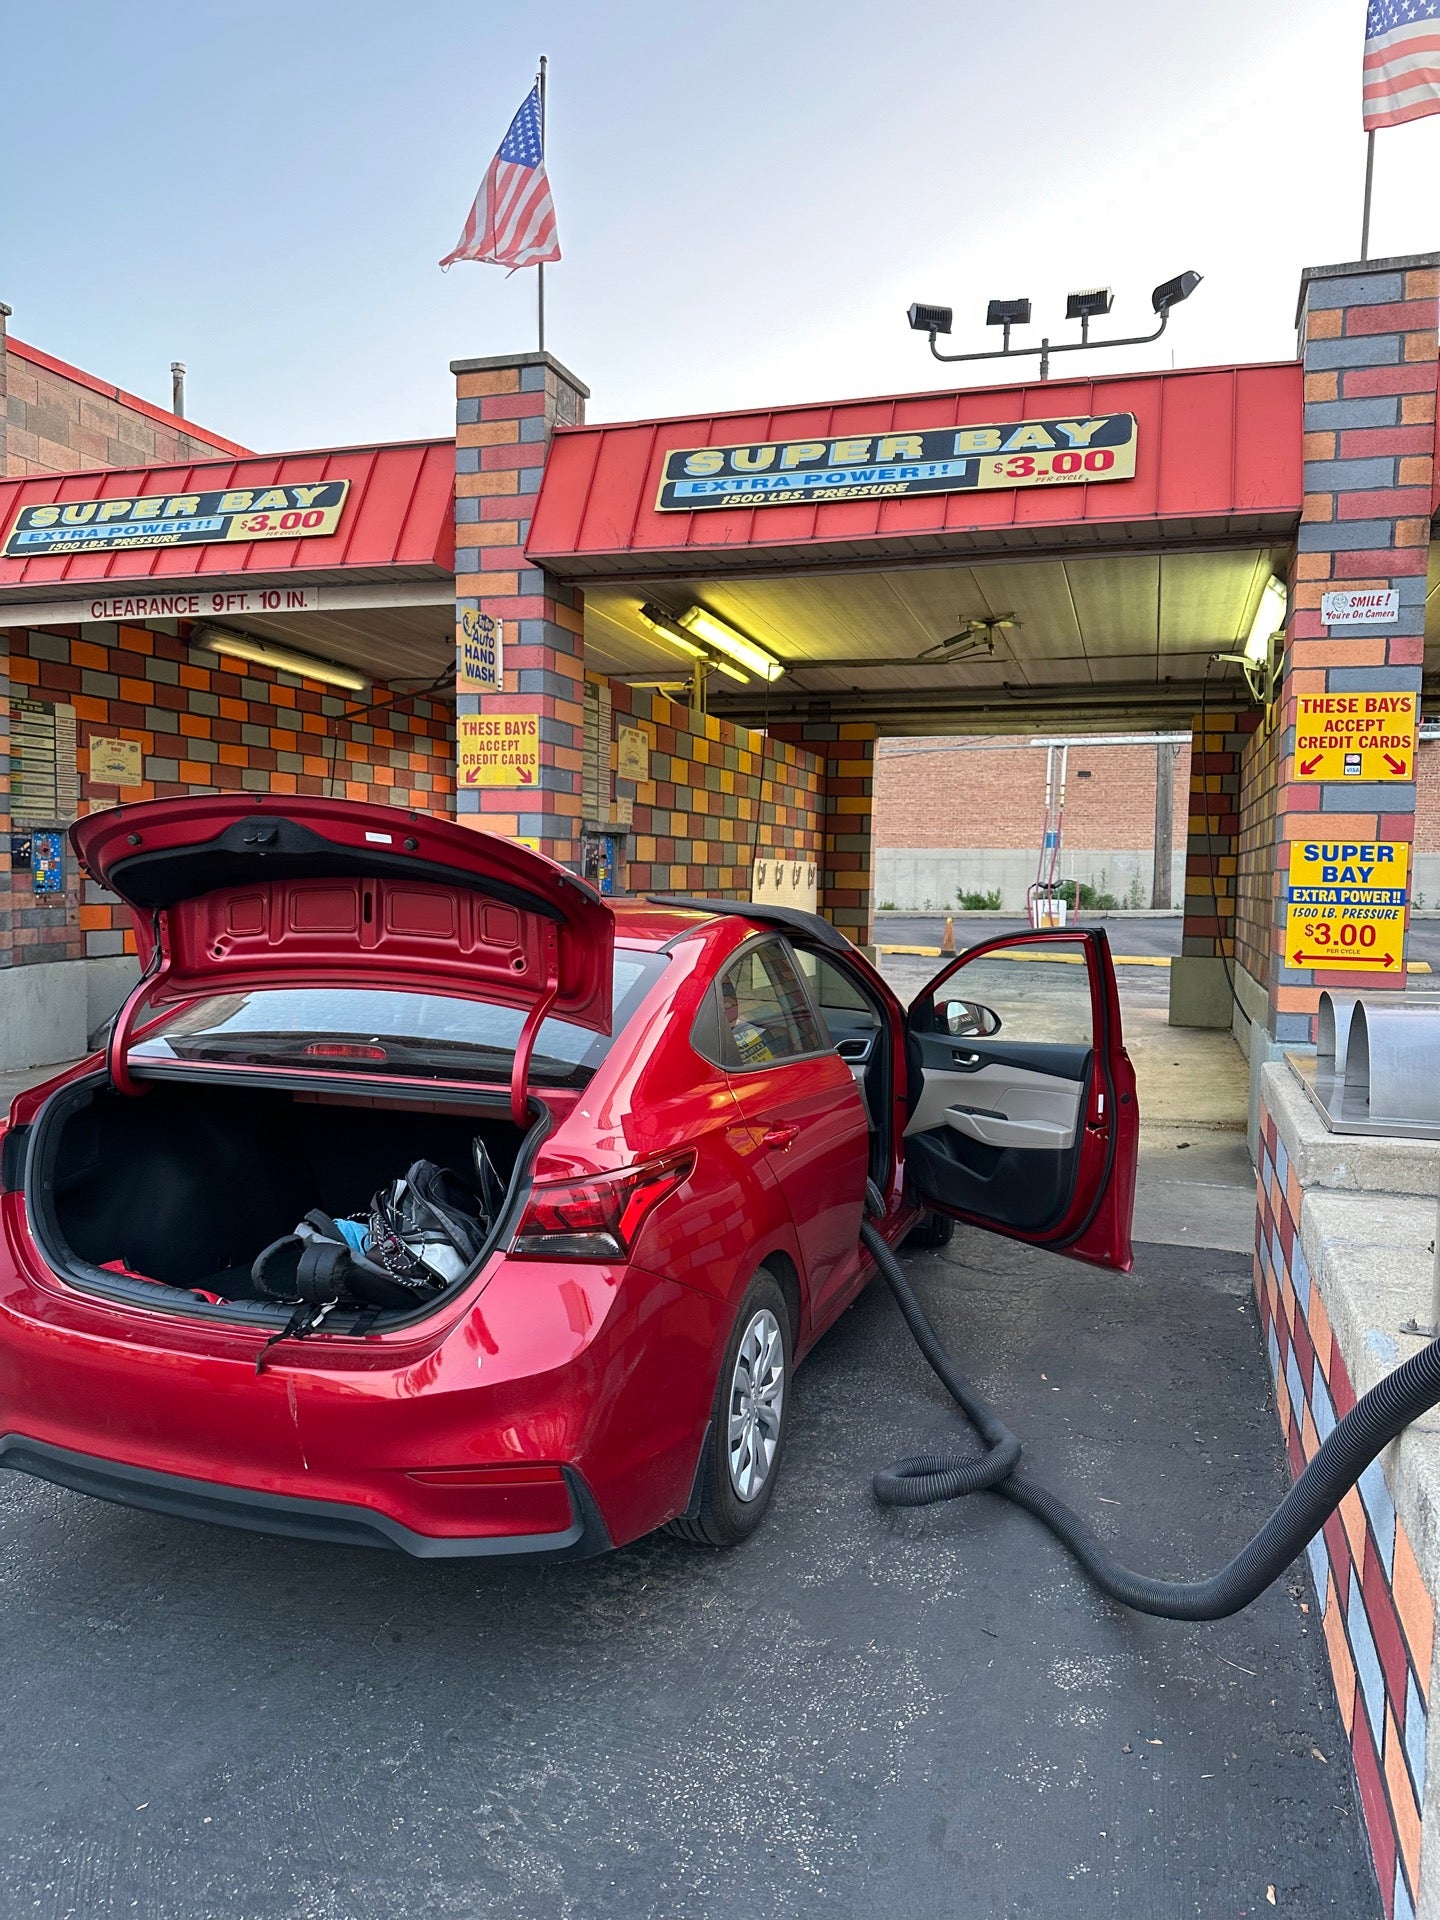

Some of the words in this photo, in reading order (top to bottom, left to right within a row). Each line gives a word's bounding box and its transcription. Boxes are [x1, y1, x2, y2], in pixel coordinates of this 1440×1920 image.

[683, 434, 923, 477] SUPER
[954, 420, 1110, 455] BAY
[993, 449, 1115, 478] $3.00
[691, 476, 793, 494] EXTRA
[721, 493, 765, 506] 1500
[769, 490, 806, 502] LBS.
[813, 483, 910, 500] PRESSURE
[29, 496, 200, 527] SUPER
[216, 484, 330, 514] BAY
[240, 510, 325, 532] $3.00
[28, 528, 100, 542] EXTRA
[48, 542, 80, 551] 1500
[81, 539, 107, 548] LBS.
[112, 534, 182, 547] PRESSURE
[91, 596, 200, 619] CLEARANCE
[259, 590, 281, 609] 10
[286, 591, 308, 608] IN.
[1327, 610, 1350, 620] You're
[1352, 610, 1364, 619] On
[1365, 609, 1395, 619] Camera
[472, 629, 495, 648] Auto
[465, 643, 495, 665] HAND
[465, 662, 495, 683] WASH
[1302, 698, 1358, 714] THESE
[1365, 697, 1412, 713] BAYS
[462, 722, 500, 736] THESE
[504, 721, 536, 735] BAYS
[1324, 719, 1385, 732] ACCEPT
[479, 740, 520, 751] ACCEPT
[1298, 736, 1353, 749] CREDIT
[1359, 735, 1411, 749] CARDS
[462, 754, 499, 765] CREDIT
[501, 753, 536, 765] CARDS
[1304, 844, 1394, 862] SUPER
[1322, 866, 1374, 883] BAY
[1293, 889, 1337, 902] EXTRA
[1292, 908, 1318, 918] 1500
[1321, 908, 1338, 918] LB.
[1342, 908, 1399, 920] PRESSURE
[1305, 923, 1376, 947] $3.00
